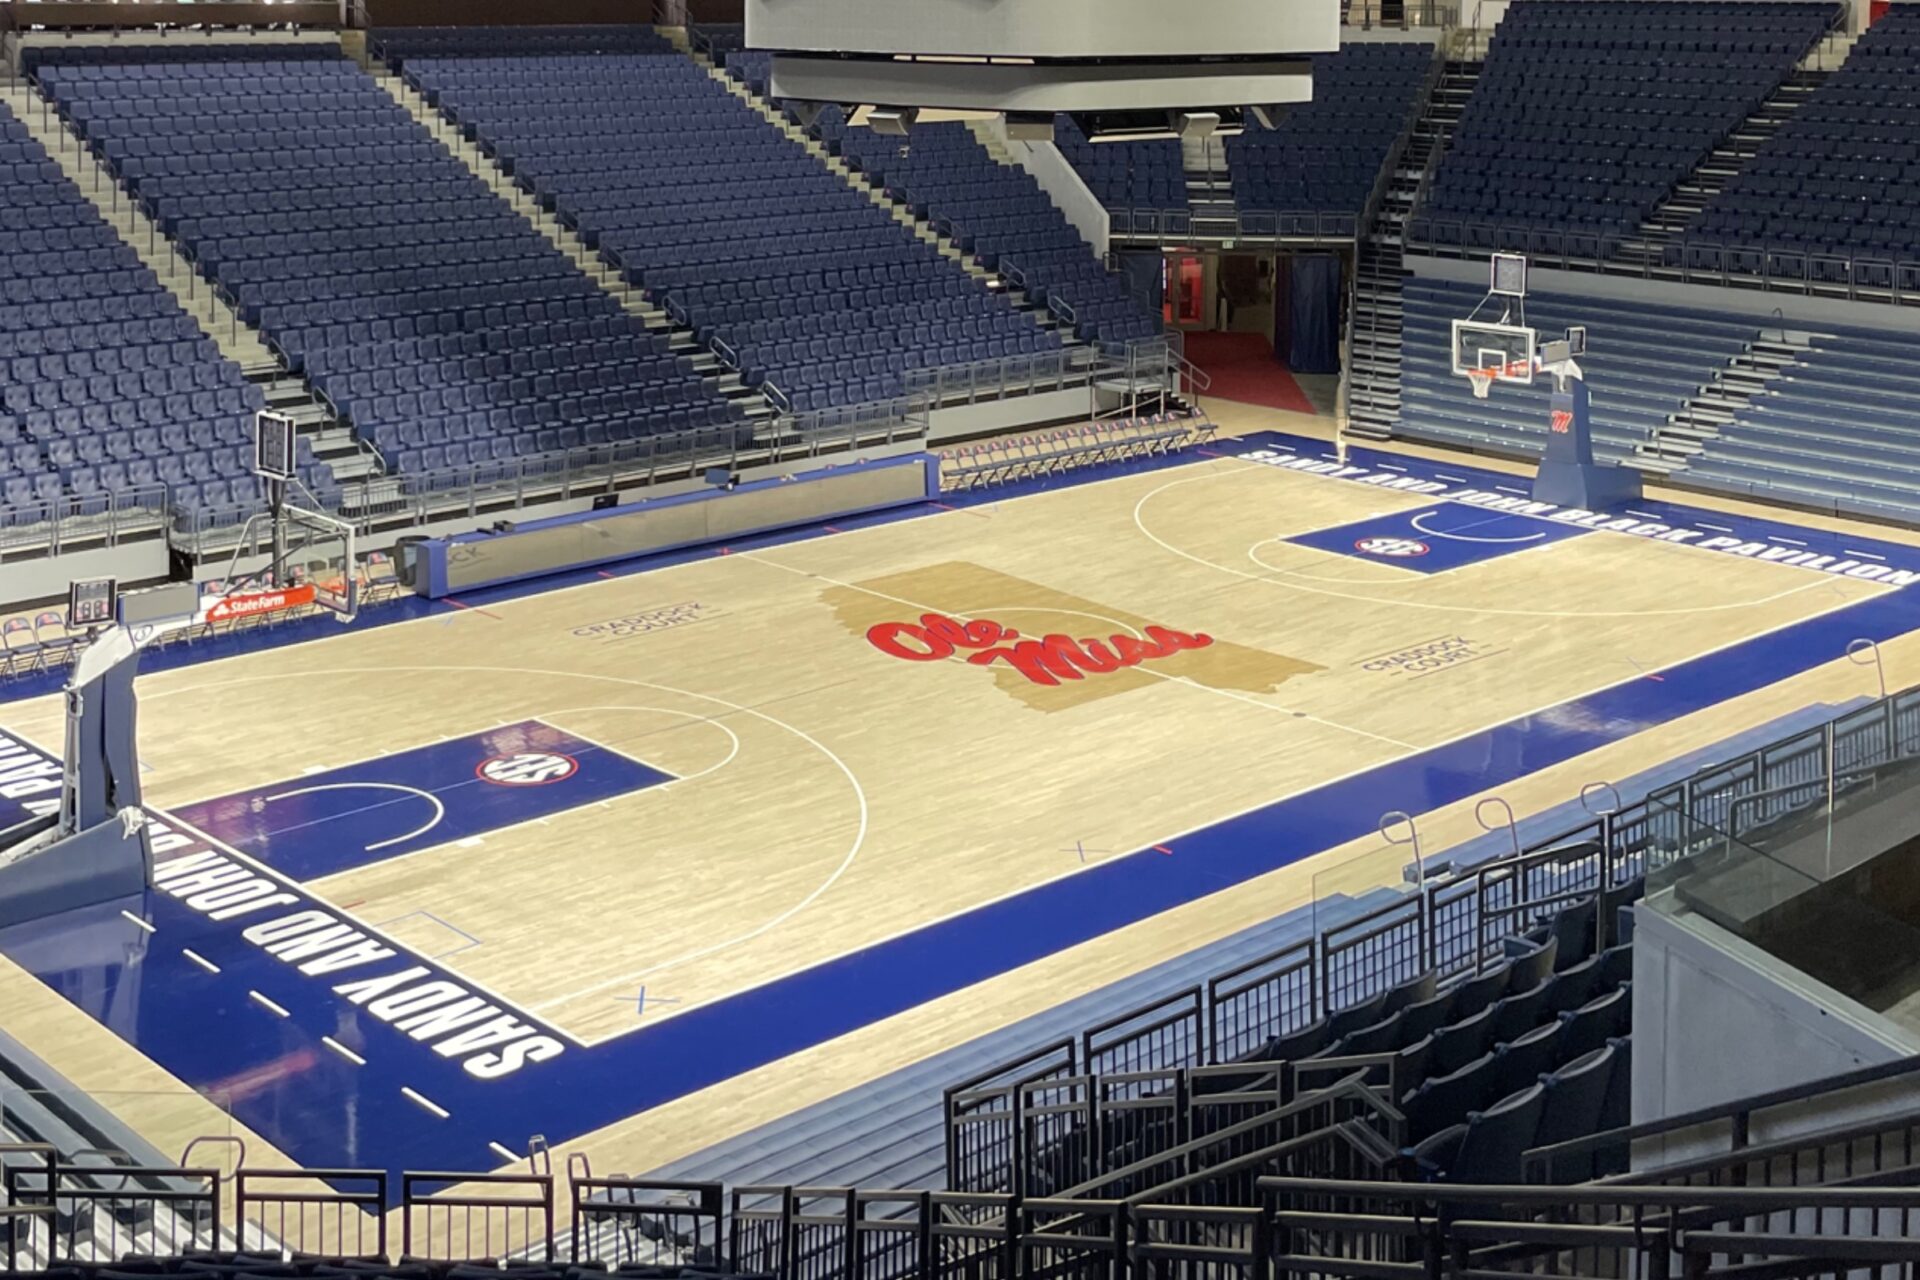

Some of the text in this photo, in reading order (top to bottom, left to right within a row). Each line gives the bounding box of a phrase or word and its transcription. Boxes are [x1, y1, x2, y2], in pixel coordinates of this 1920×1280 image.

[1238, 449, 1920, 585] SANDY AND JOHN BLACK PAVILION
[1358, 538, 1426, 556] SEC
[572, 602, 700, 636] CRADDOCK
[866, 613, 1020, 662] Ole
[967, 625, 1215, 687] Miss
[1362, 636, 1476, 671] CRADDOCK
[1404, 647, 1479, 672] COURT
[153, 850, 565, 1079] SANDY AND JOHN
